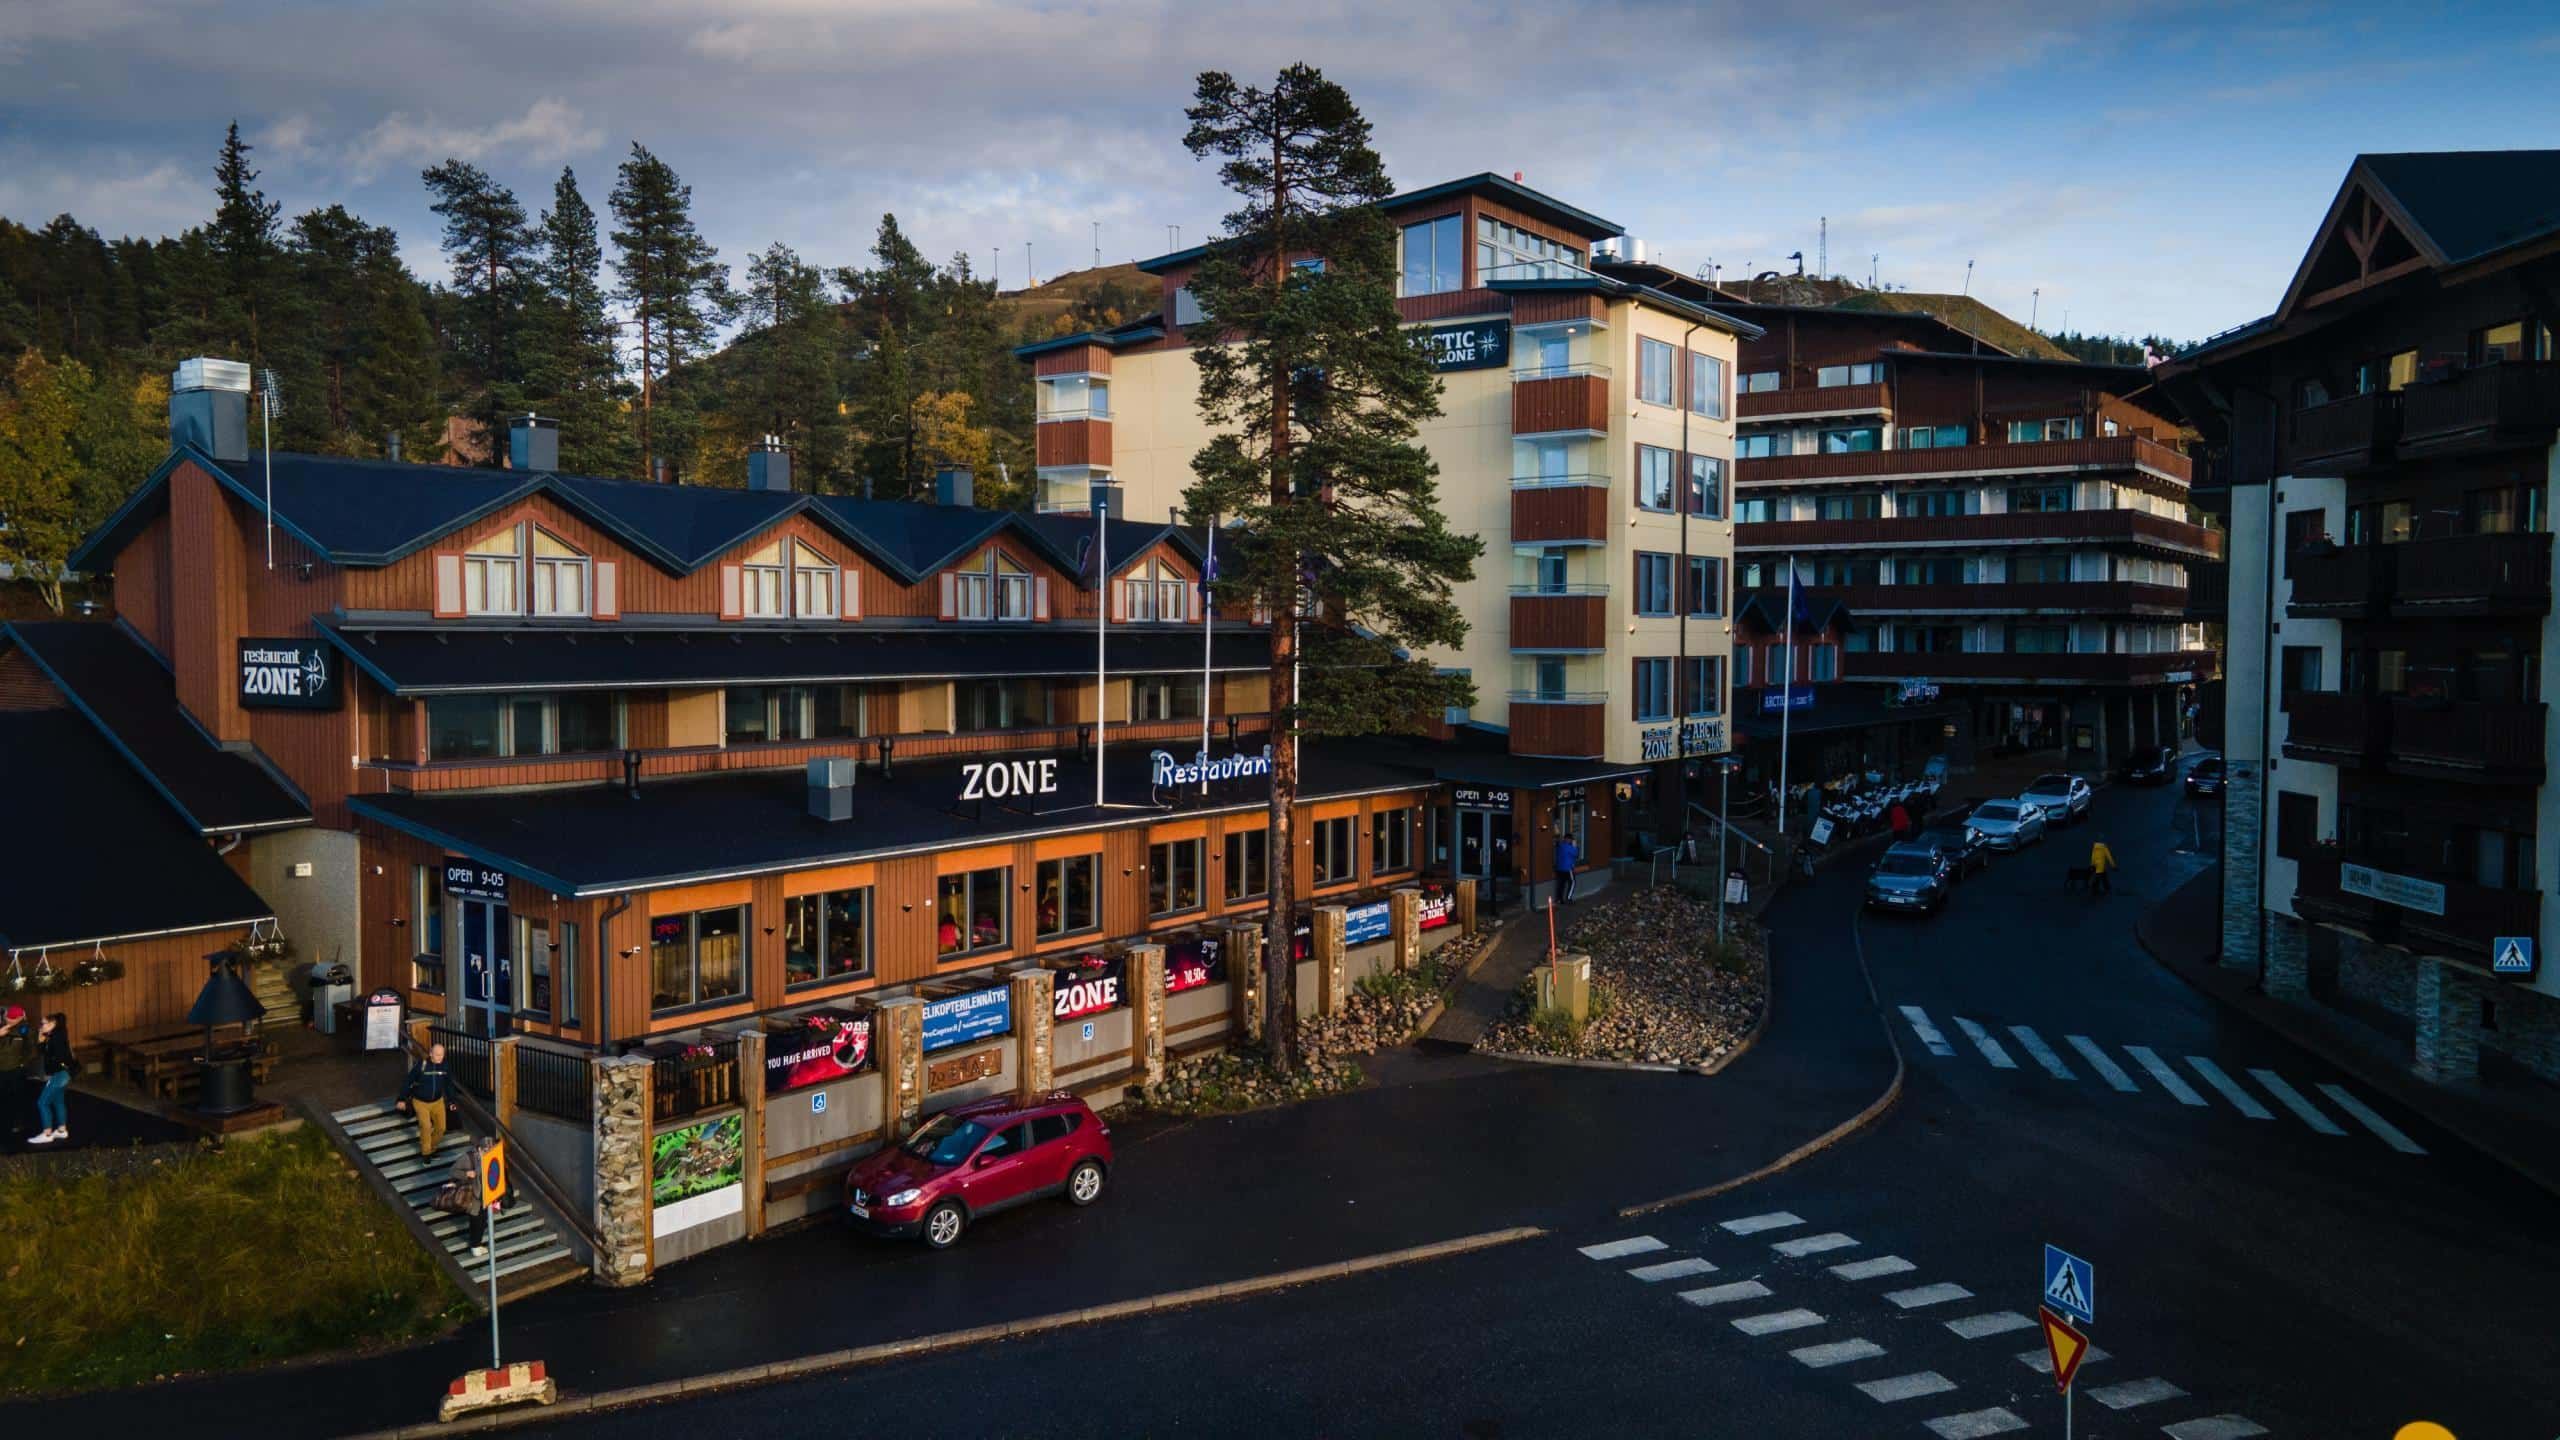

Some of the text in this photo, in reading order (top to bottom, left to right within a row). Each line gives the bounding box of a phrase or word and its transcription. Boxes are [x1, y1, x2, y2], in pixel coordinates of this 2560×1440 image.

[1438, 348, 1476, 364] ZONE
[243, 648, 301, 665] restaurant
[243, 666, 301, 696] ZONE
[1693, 721, 1725, 738] ARCTIC
[1645, 738, 1673, 760] ZONE
[961, 759, 1058, 800] ZONE
[1155, 750, 1271, 787] Restauran
[1455, 790, 1480, 801] OPEN
[447, 866, 505, 887] OPEN 9-05
[922, 989, 1007, 1020] ELIKOPTERILENNÄTYS
[1054, 981, 1119, 1016] ZONE
[767, 1045, 831, 1070] YOU HAVE ARRIVED
